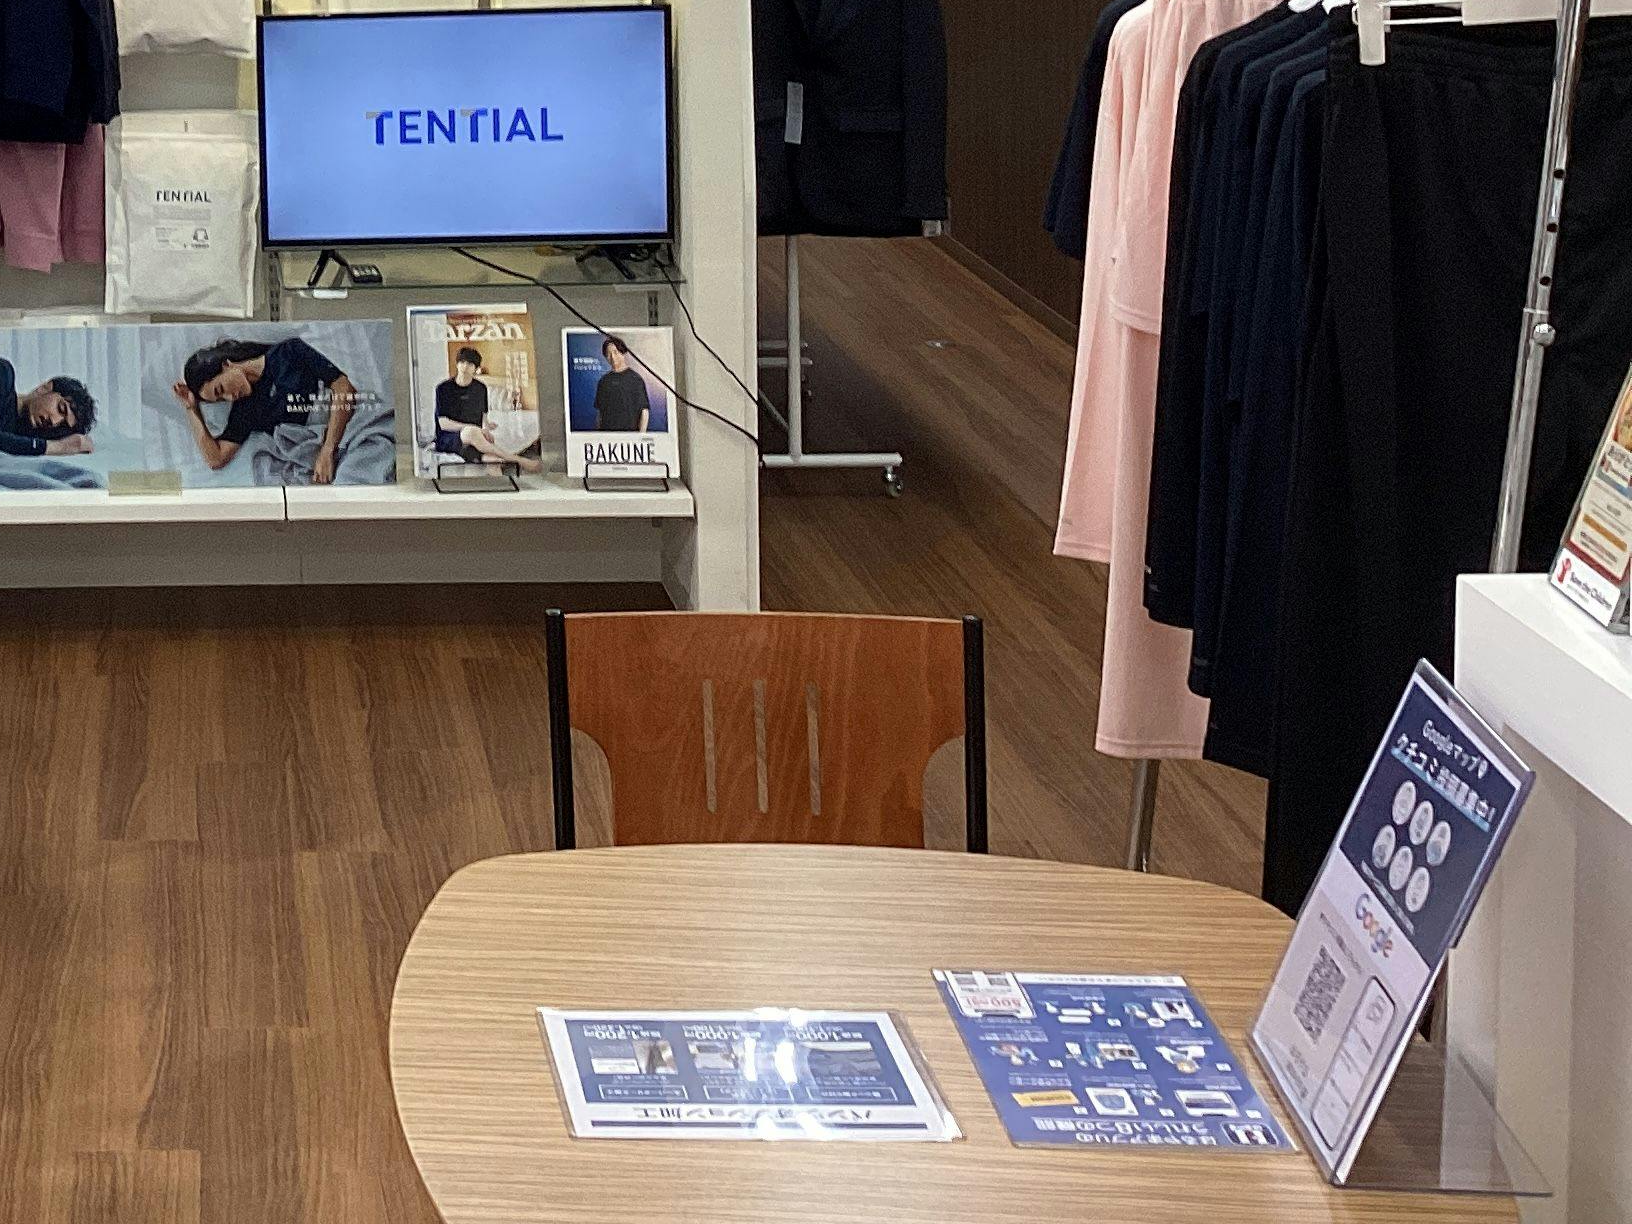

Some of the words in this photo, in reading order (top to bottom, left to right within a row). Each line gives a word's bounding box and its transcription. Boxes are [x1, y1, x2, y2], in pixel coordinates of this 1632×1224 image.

[365, 107, 564, 147] TENTIAL
[156, 190, 212, 203] TENTIAL
[584, 440, 655, 464] BAKUNE
[1356, 893, 1395, 959] Google
